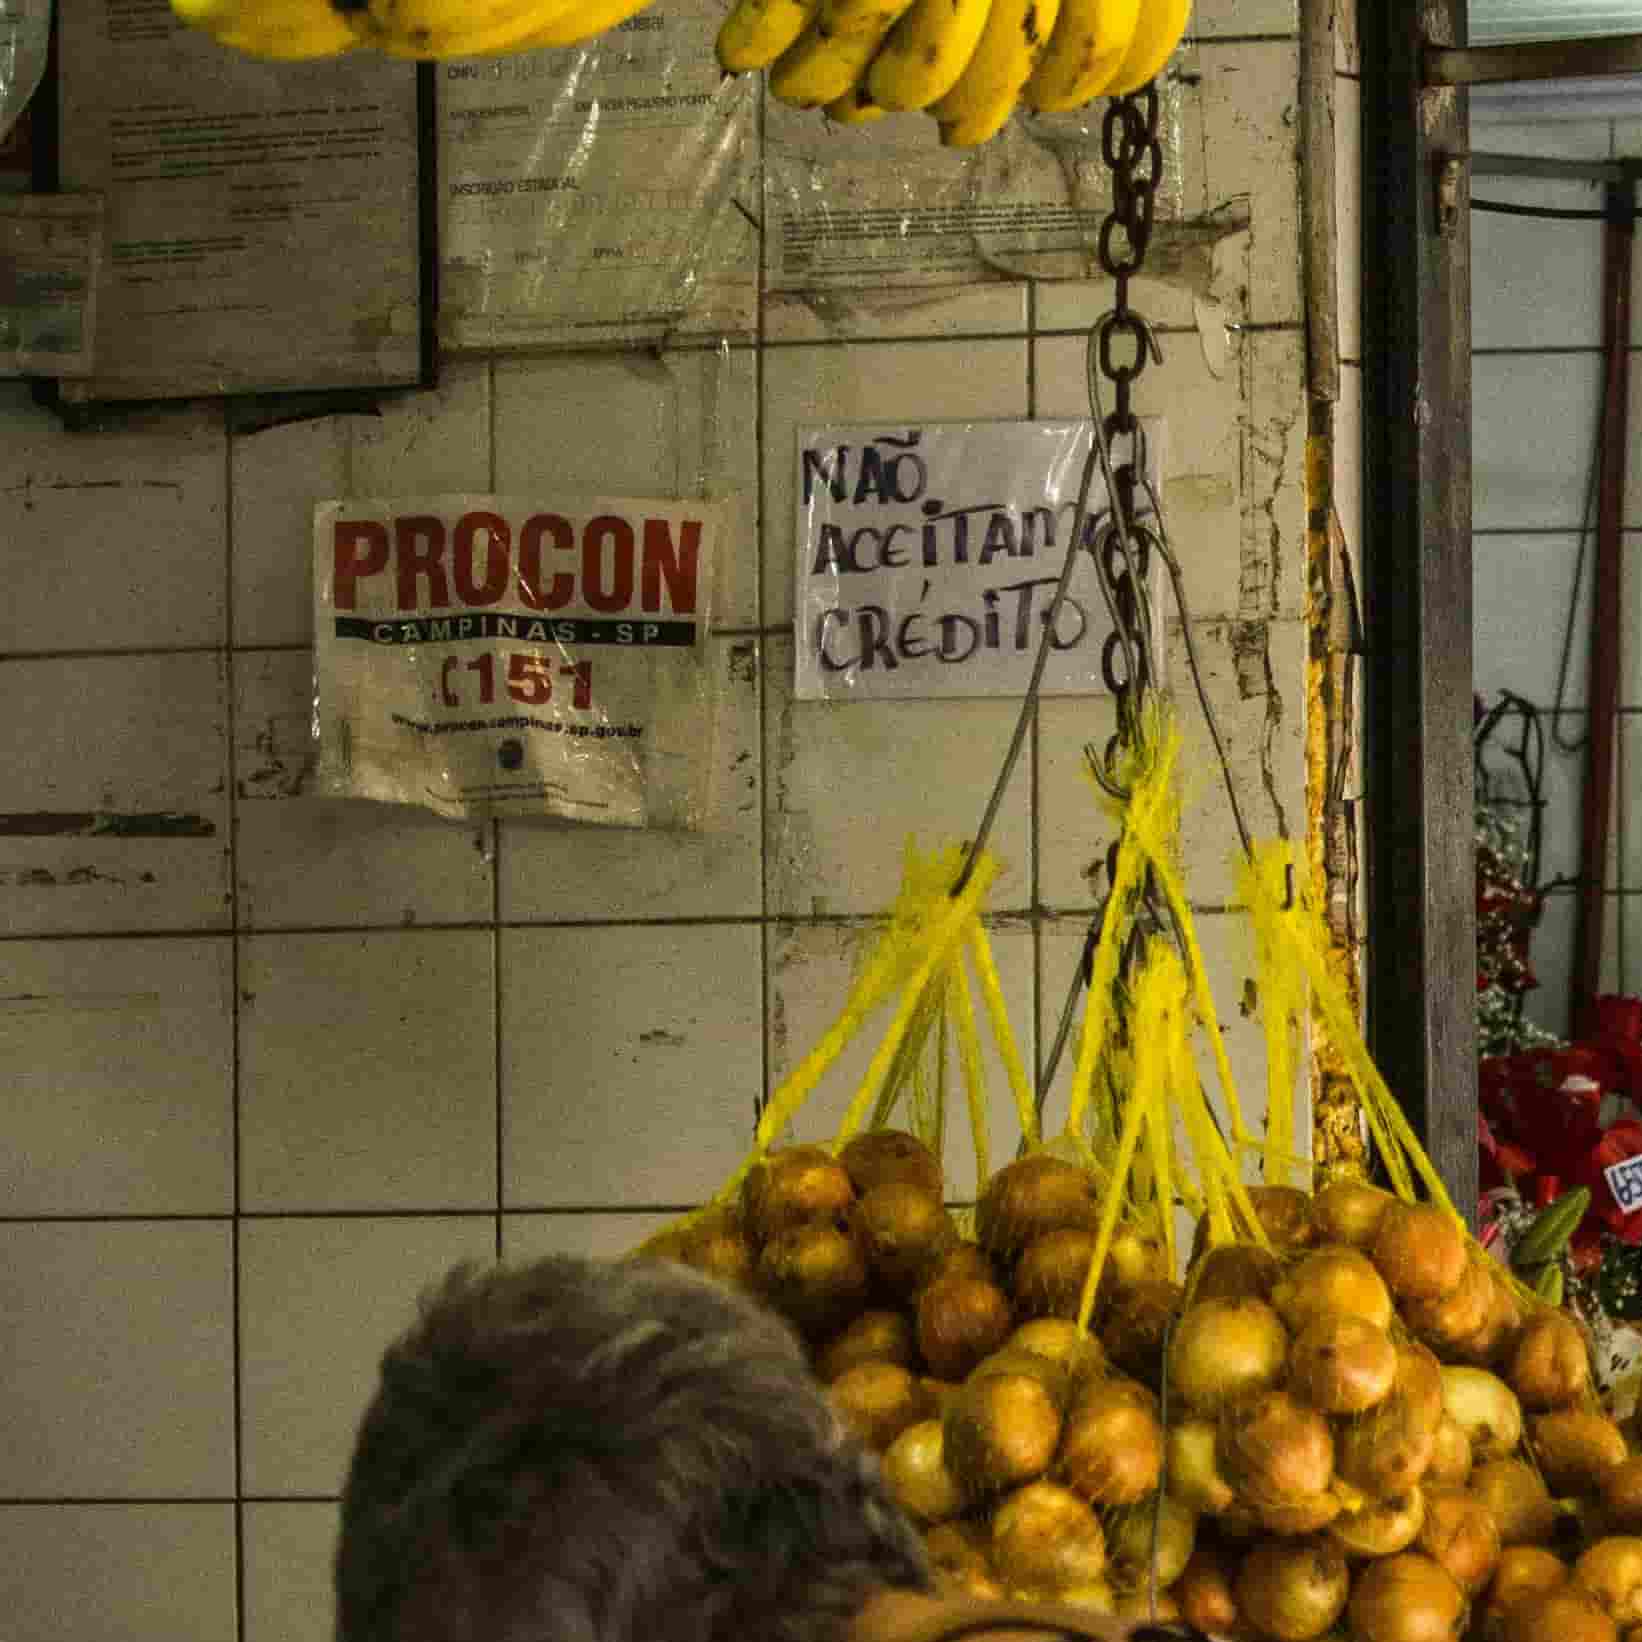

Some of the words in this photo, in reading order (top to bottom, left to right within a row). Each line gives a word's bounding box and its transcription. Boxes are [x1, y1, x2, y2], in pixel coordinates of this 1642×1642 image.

[802, 430, 928, 505] NÃO
[334, 511, 703, 614] PROCON
[374, 618, 577, 644] CAMPINAS
[616, 623, 660, 643] SP
[467, 653, 594, 710] 151
